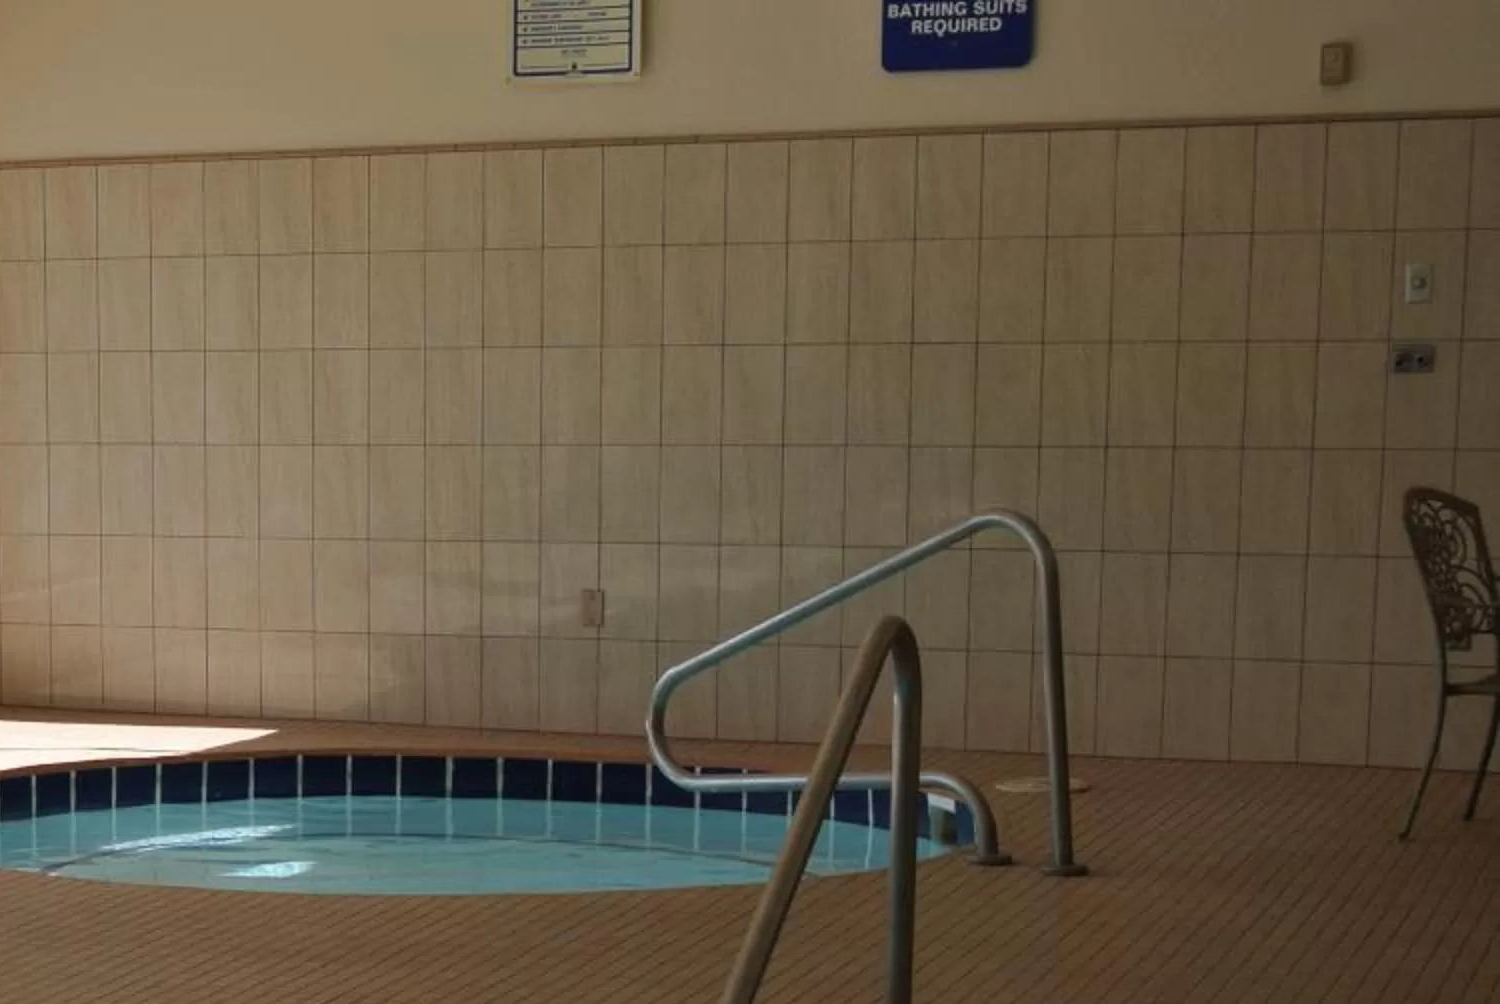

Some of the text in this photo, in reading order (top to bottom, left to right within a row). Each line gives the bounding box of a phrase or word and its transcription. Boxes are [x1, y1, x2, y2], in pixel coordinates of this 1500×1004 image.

[887, 0, 1028, 18] BATHING SUITS
[911, 17, 1003, 37] REQUIRED
